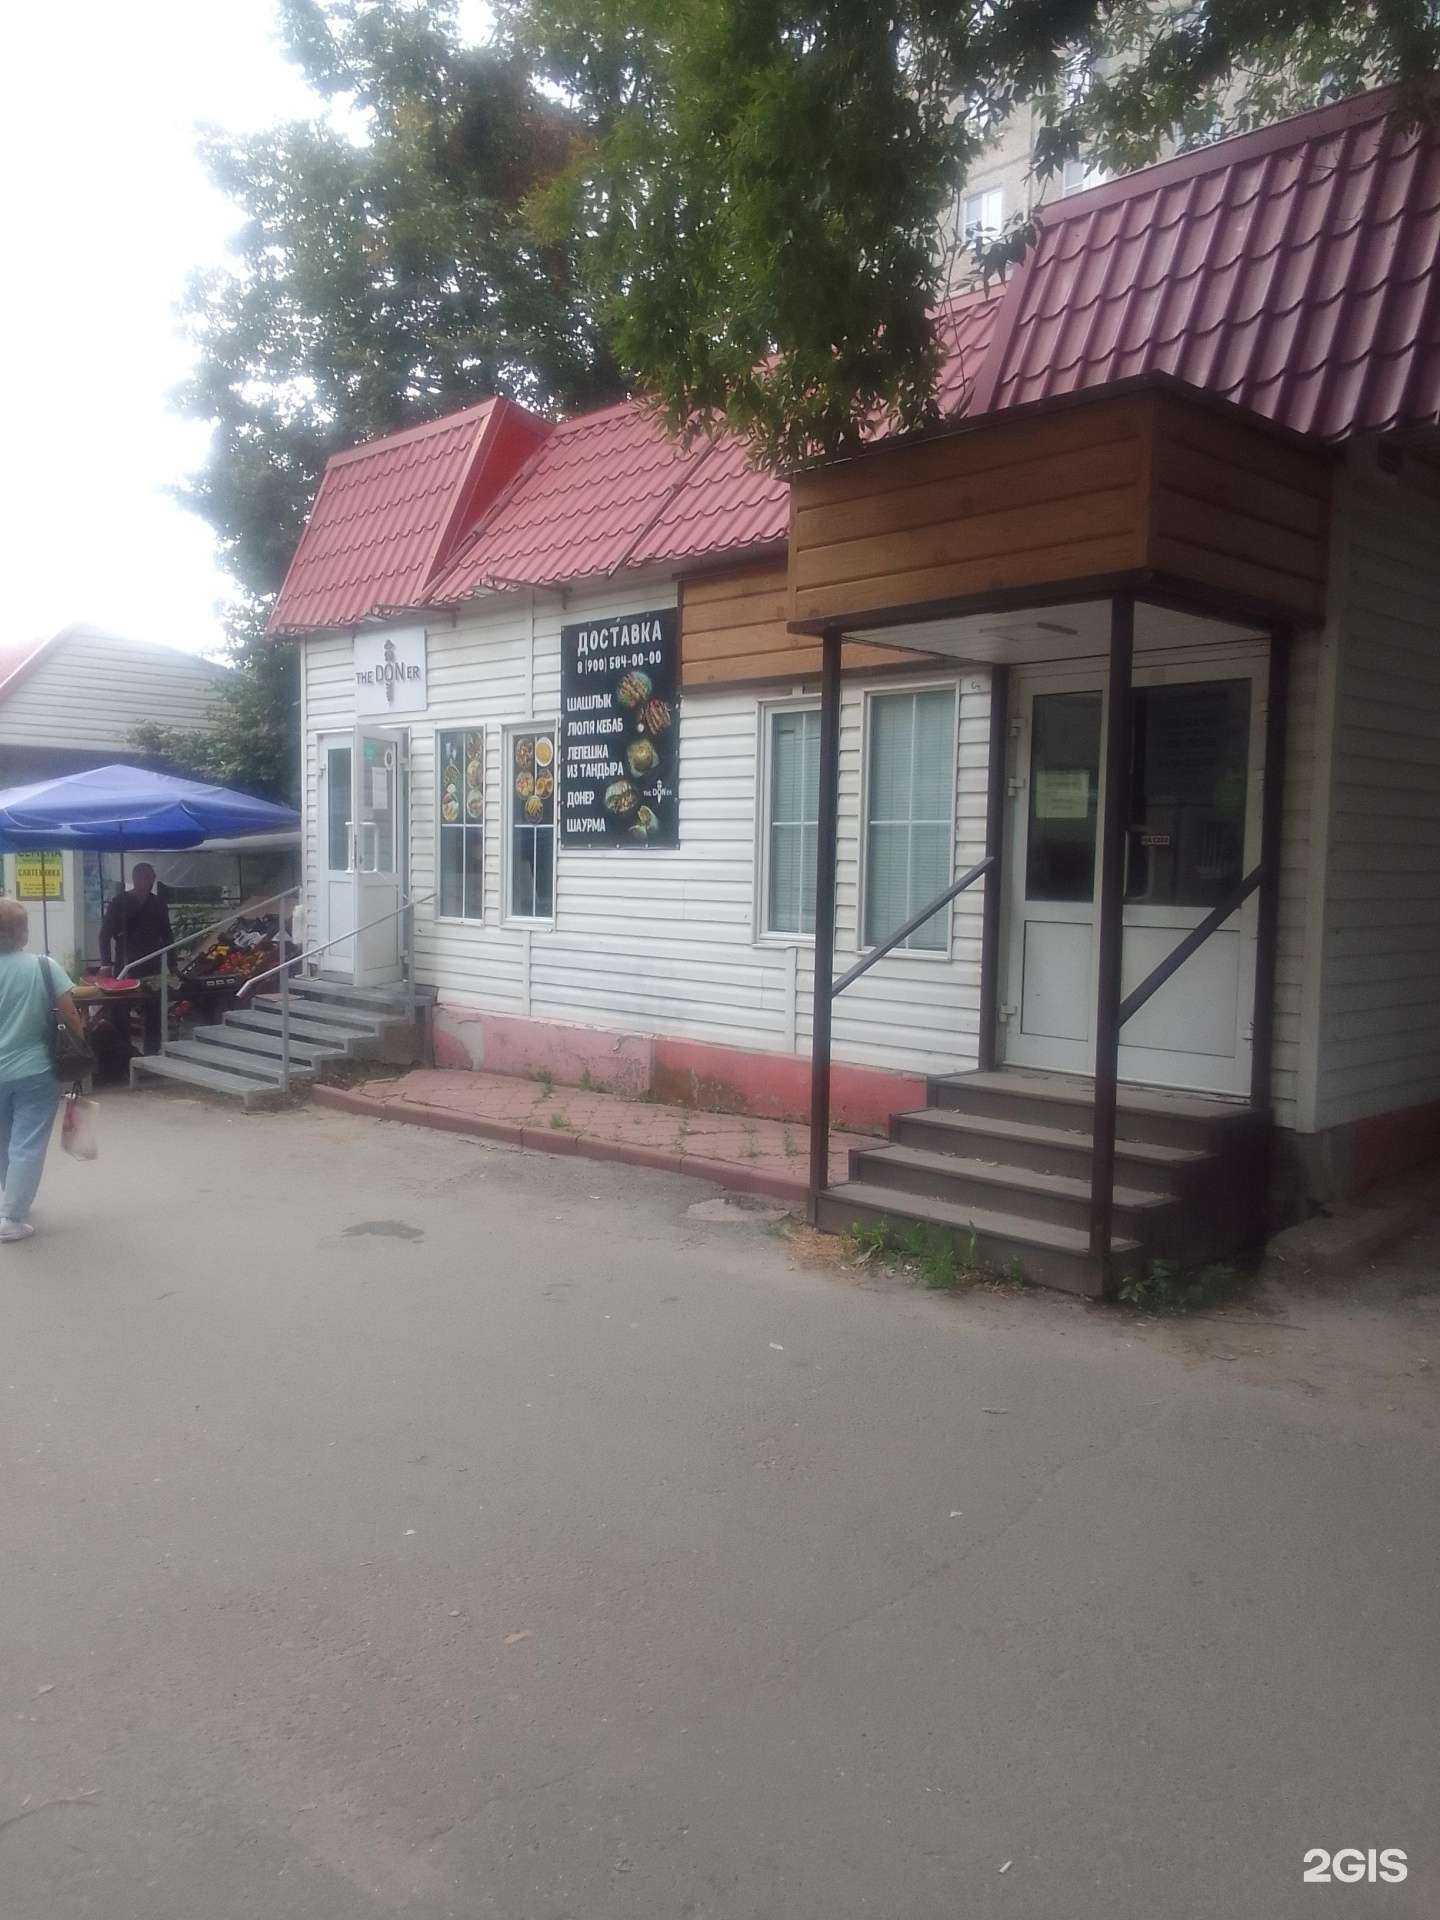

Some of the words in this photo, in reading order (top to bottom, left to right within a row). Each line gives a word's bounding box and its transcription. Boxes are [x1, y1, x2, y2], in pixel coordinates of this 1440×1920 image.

[577, 619, 662, 657] ДОСТАВКА
[356, 670, 374, 685] THE
[375, 661, 420, 682] DONER
[577, 660, 583, 674] 8
[585, 656, 607, 676] (900)
[566, 693, 612, 712] ШАШЛЫК
[567, 720, 595, 737] ЛЮЛЯ
[596, 717, 624, 734] КЕБАБ
[567, 744, 609, 761] ЛЕПЕШКА
[566, 763, 578, 779] ИЗ
[580, 761, 624, 780] ТАНДЫРА
[567, 791, 595, 808] ДОНЕР
[566, 817, 606, 833] ШАУРМА
